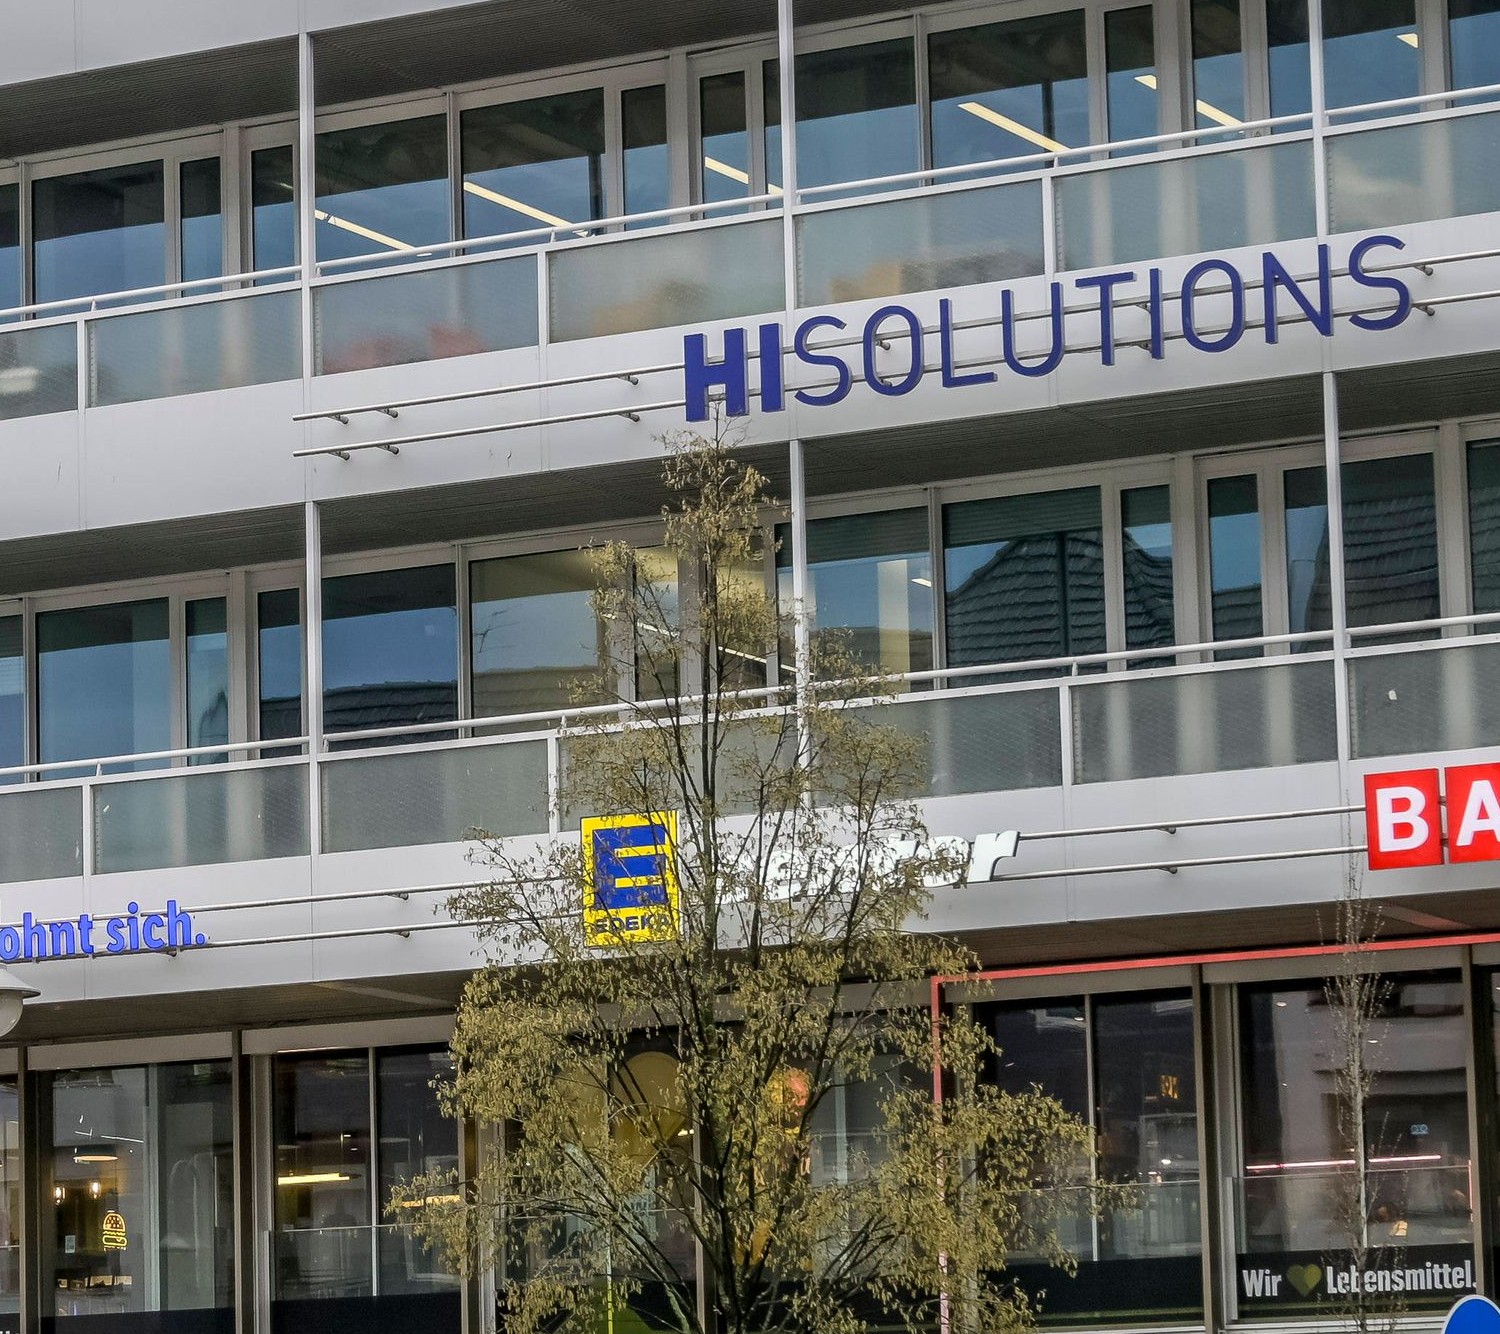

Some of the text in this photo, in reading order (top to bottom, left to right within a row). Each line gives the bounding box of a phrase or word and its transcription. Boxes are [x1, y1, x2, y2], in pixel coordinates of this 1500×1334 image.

[683, 235, 1413, 423] HISOLUTIONS
[105, 900, 206, 954] sich.
[1242, 1259, 1477, 1297] Wir Lebensmittel.
